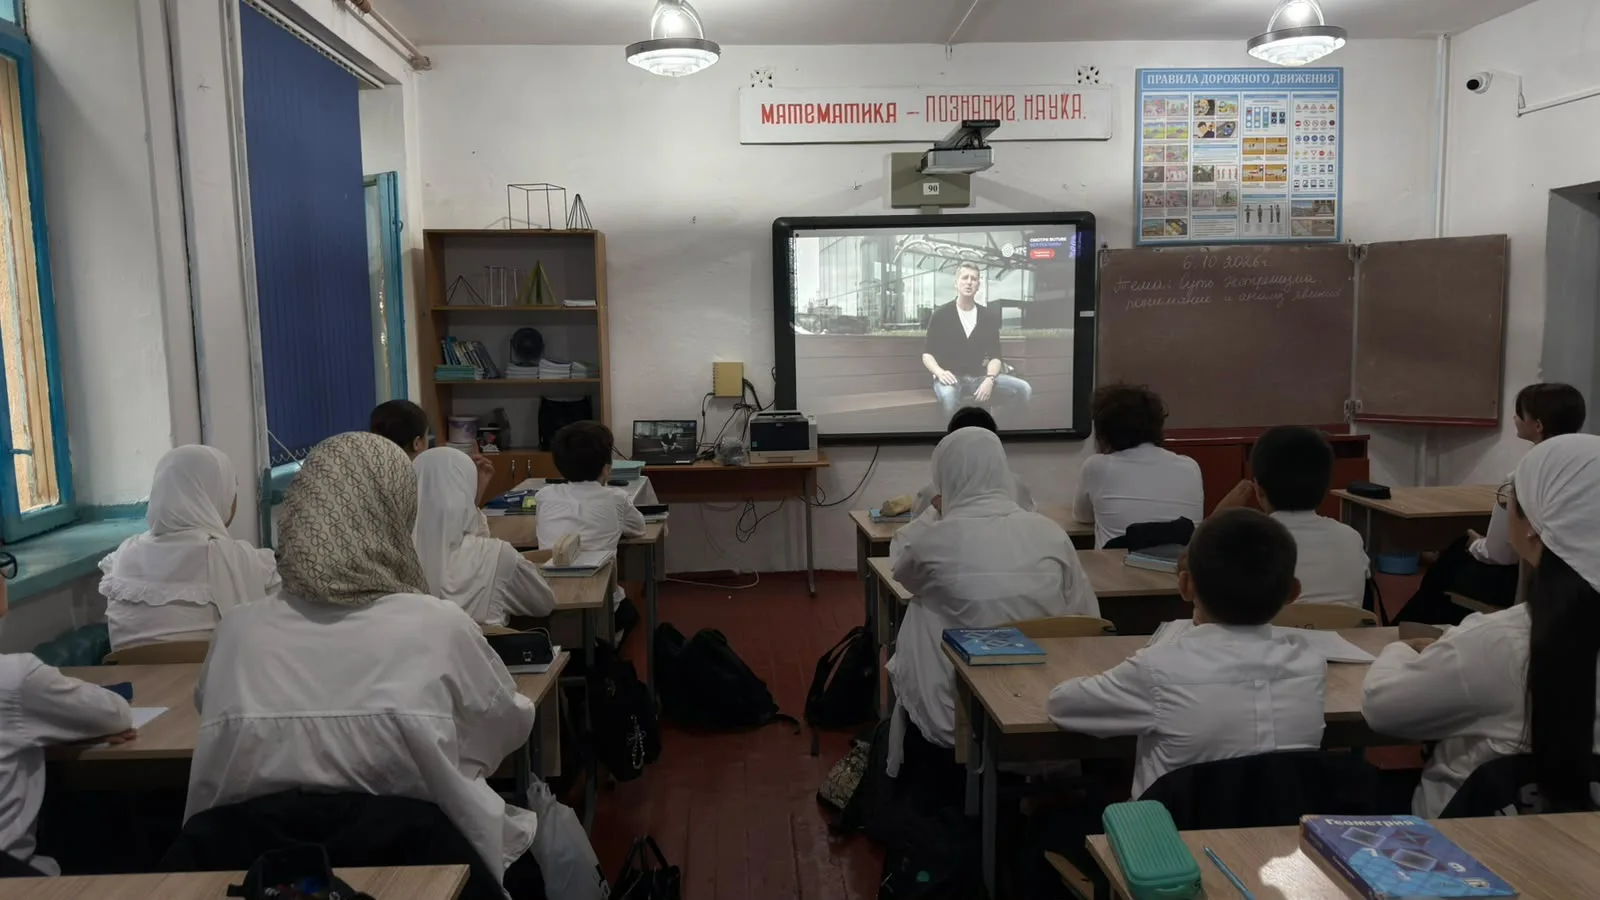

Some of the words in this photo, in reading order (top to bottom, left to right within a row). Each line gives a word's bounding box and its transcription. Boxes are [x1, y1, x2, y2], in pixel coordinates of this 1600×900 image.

[1147, 73, 1199, 85] ПРАВИЛА
[1200, 73, 1270, 85] ДОРОЖНОГО
[1271, 73, 1335, 85] ДВИЖЕНИЯ
[928, 184, 938, 192] 90
[1324, 818, 1415, 827] Геометрия
